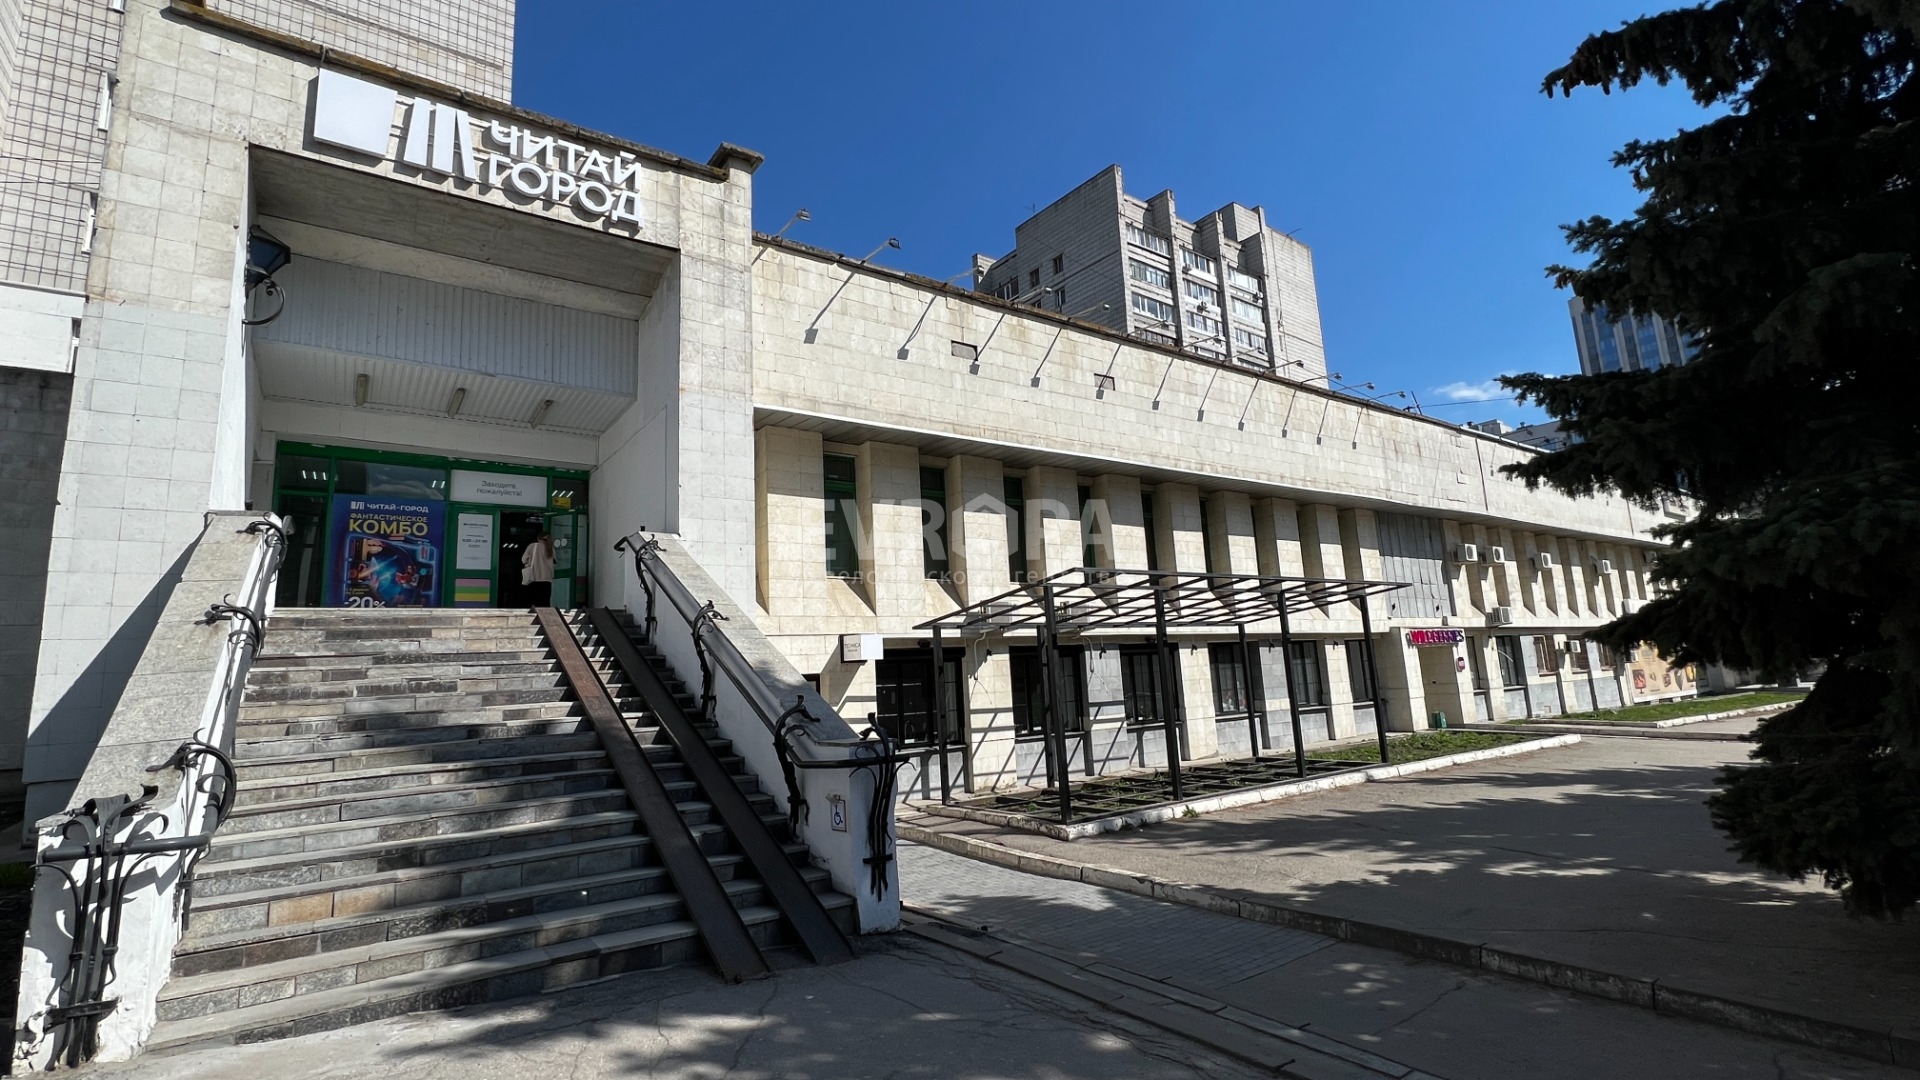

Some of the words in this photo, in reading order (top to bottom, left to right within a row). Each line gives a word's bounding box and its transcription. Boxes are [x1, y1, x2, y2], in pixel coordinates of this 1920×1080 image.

[491, 119, 642, 192] ЧИТАЙ
[488, 153, 645, 229] ГОРОД
[476, 487, 523, 497] пожалуйста!
[366, 503, 429, 513] ЧИТАЙ-ГОРОД
[350, 512, 428, 523] ФАНТАСТИЧЕСКОЕ
[348, 518, 429, 536] КОМБО
[344, 596, 386, 609] -20%
